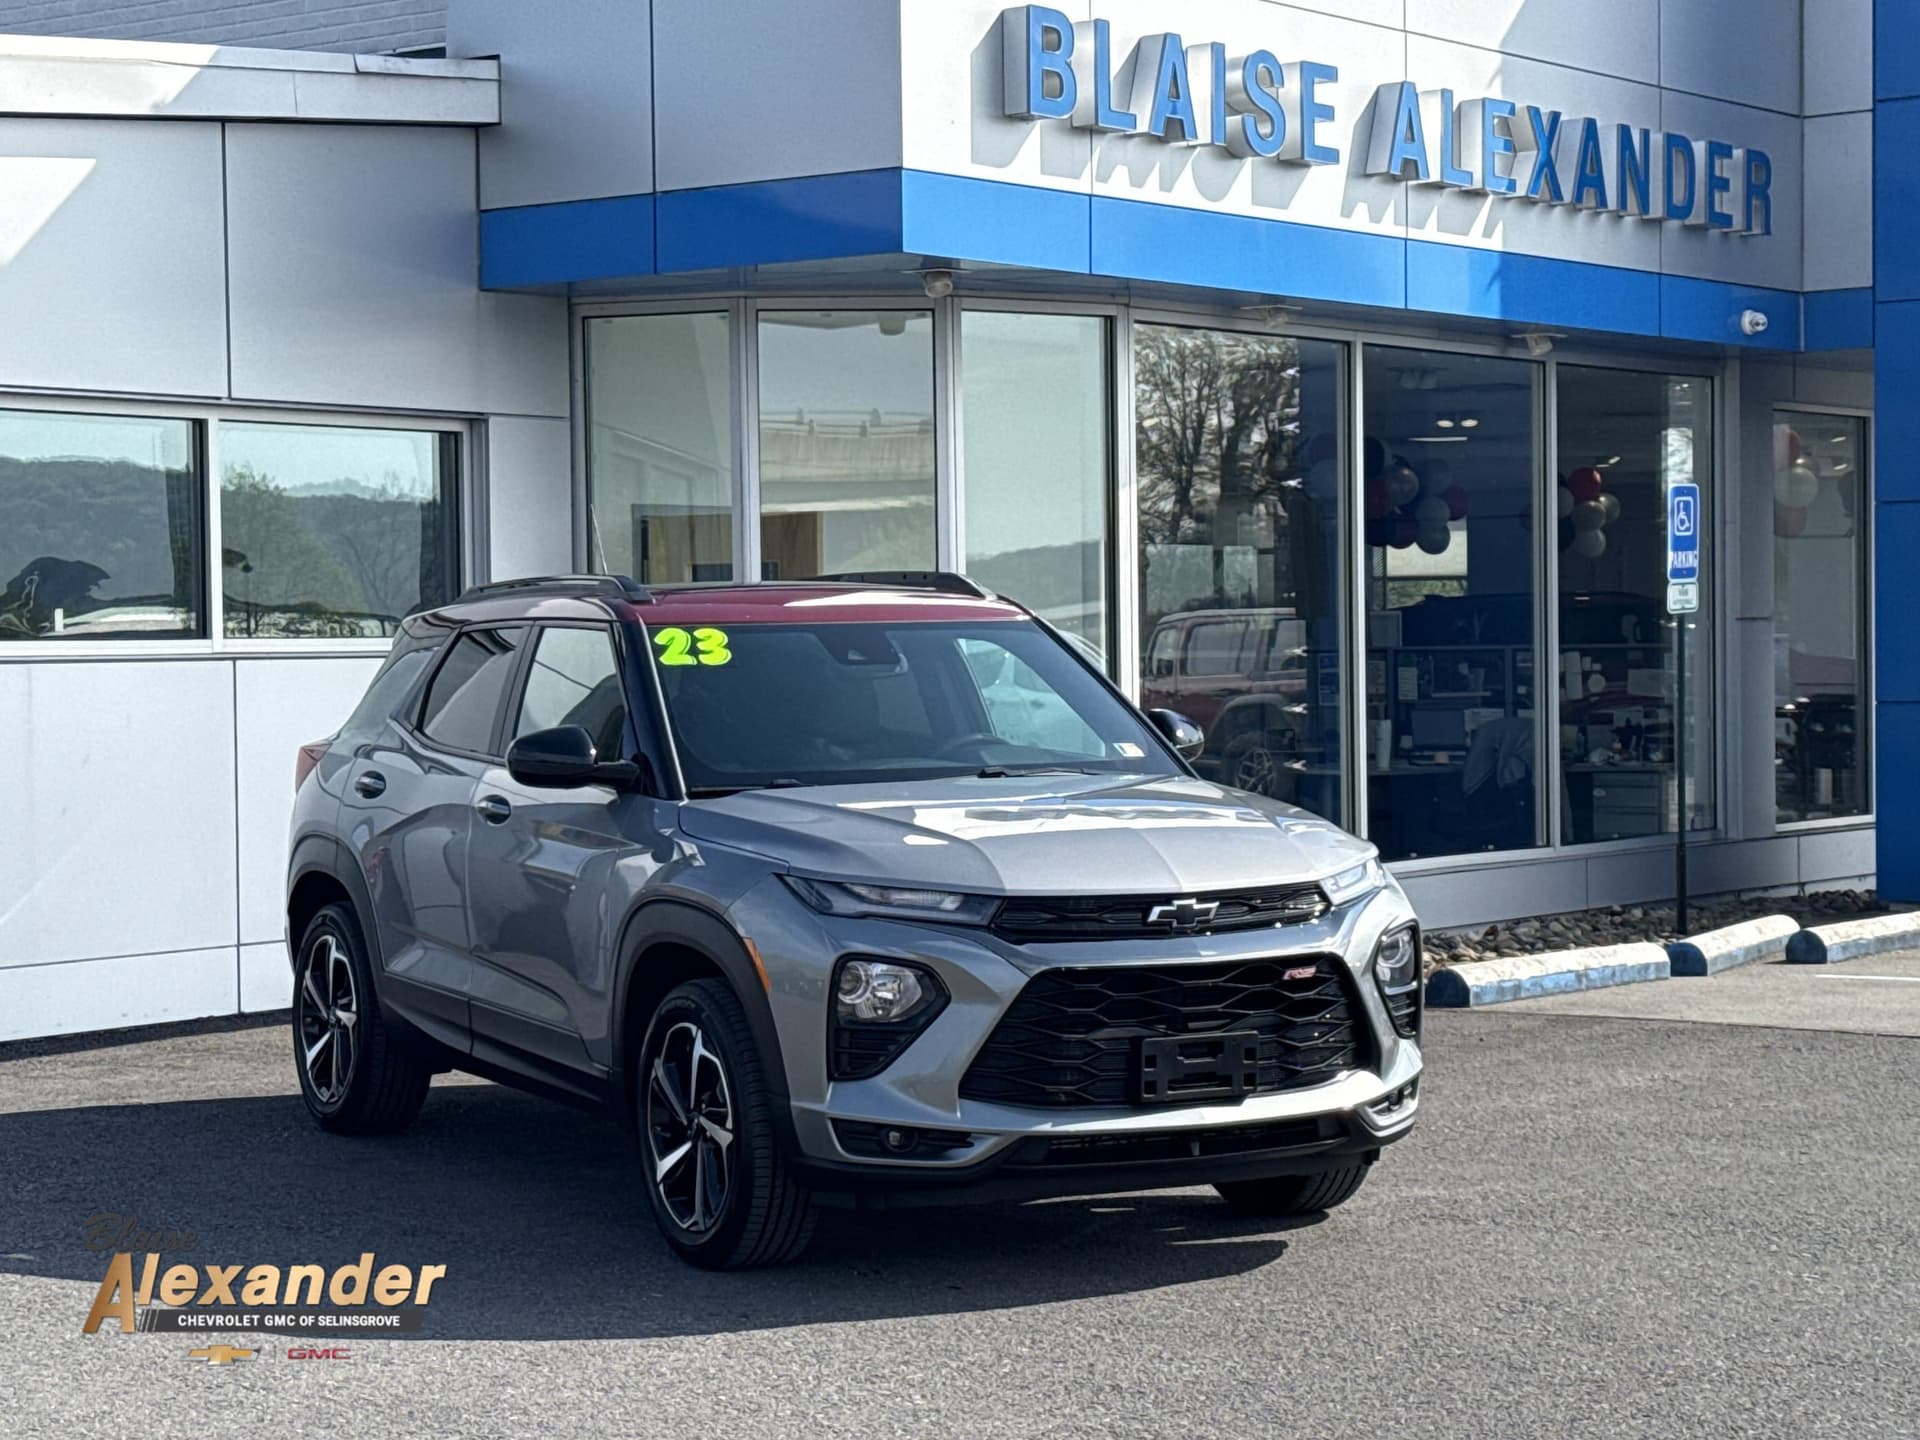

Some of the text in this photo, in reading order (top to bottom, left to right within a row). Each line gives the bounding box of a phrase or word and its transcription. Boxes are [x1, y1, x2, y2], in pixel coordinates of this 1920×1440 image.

[1024, 4, 1772, 236] BLAISE ALEXANDER
[1669, 551, 1698, 569] PARKING
[654, 627, 732, 666] 23
